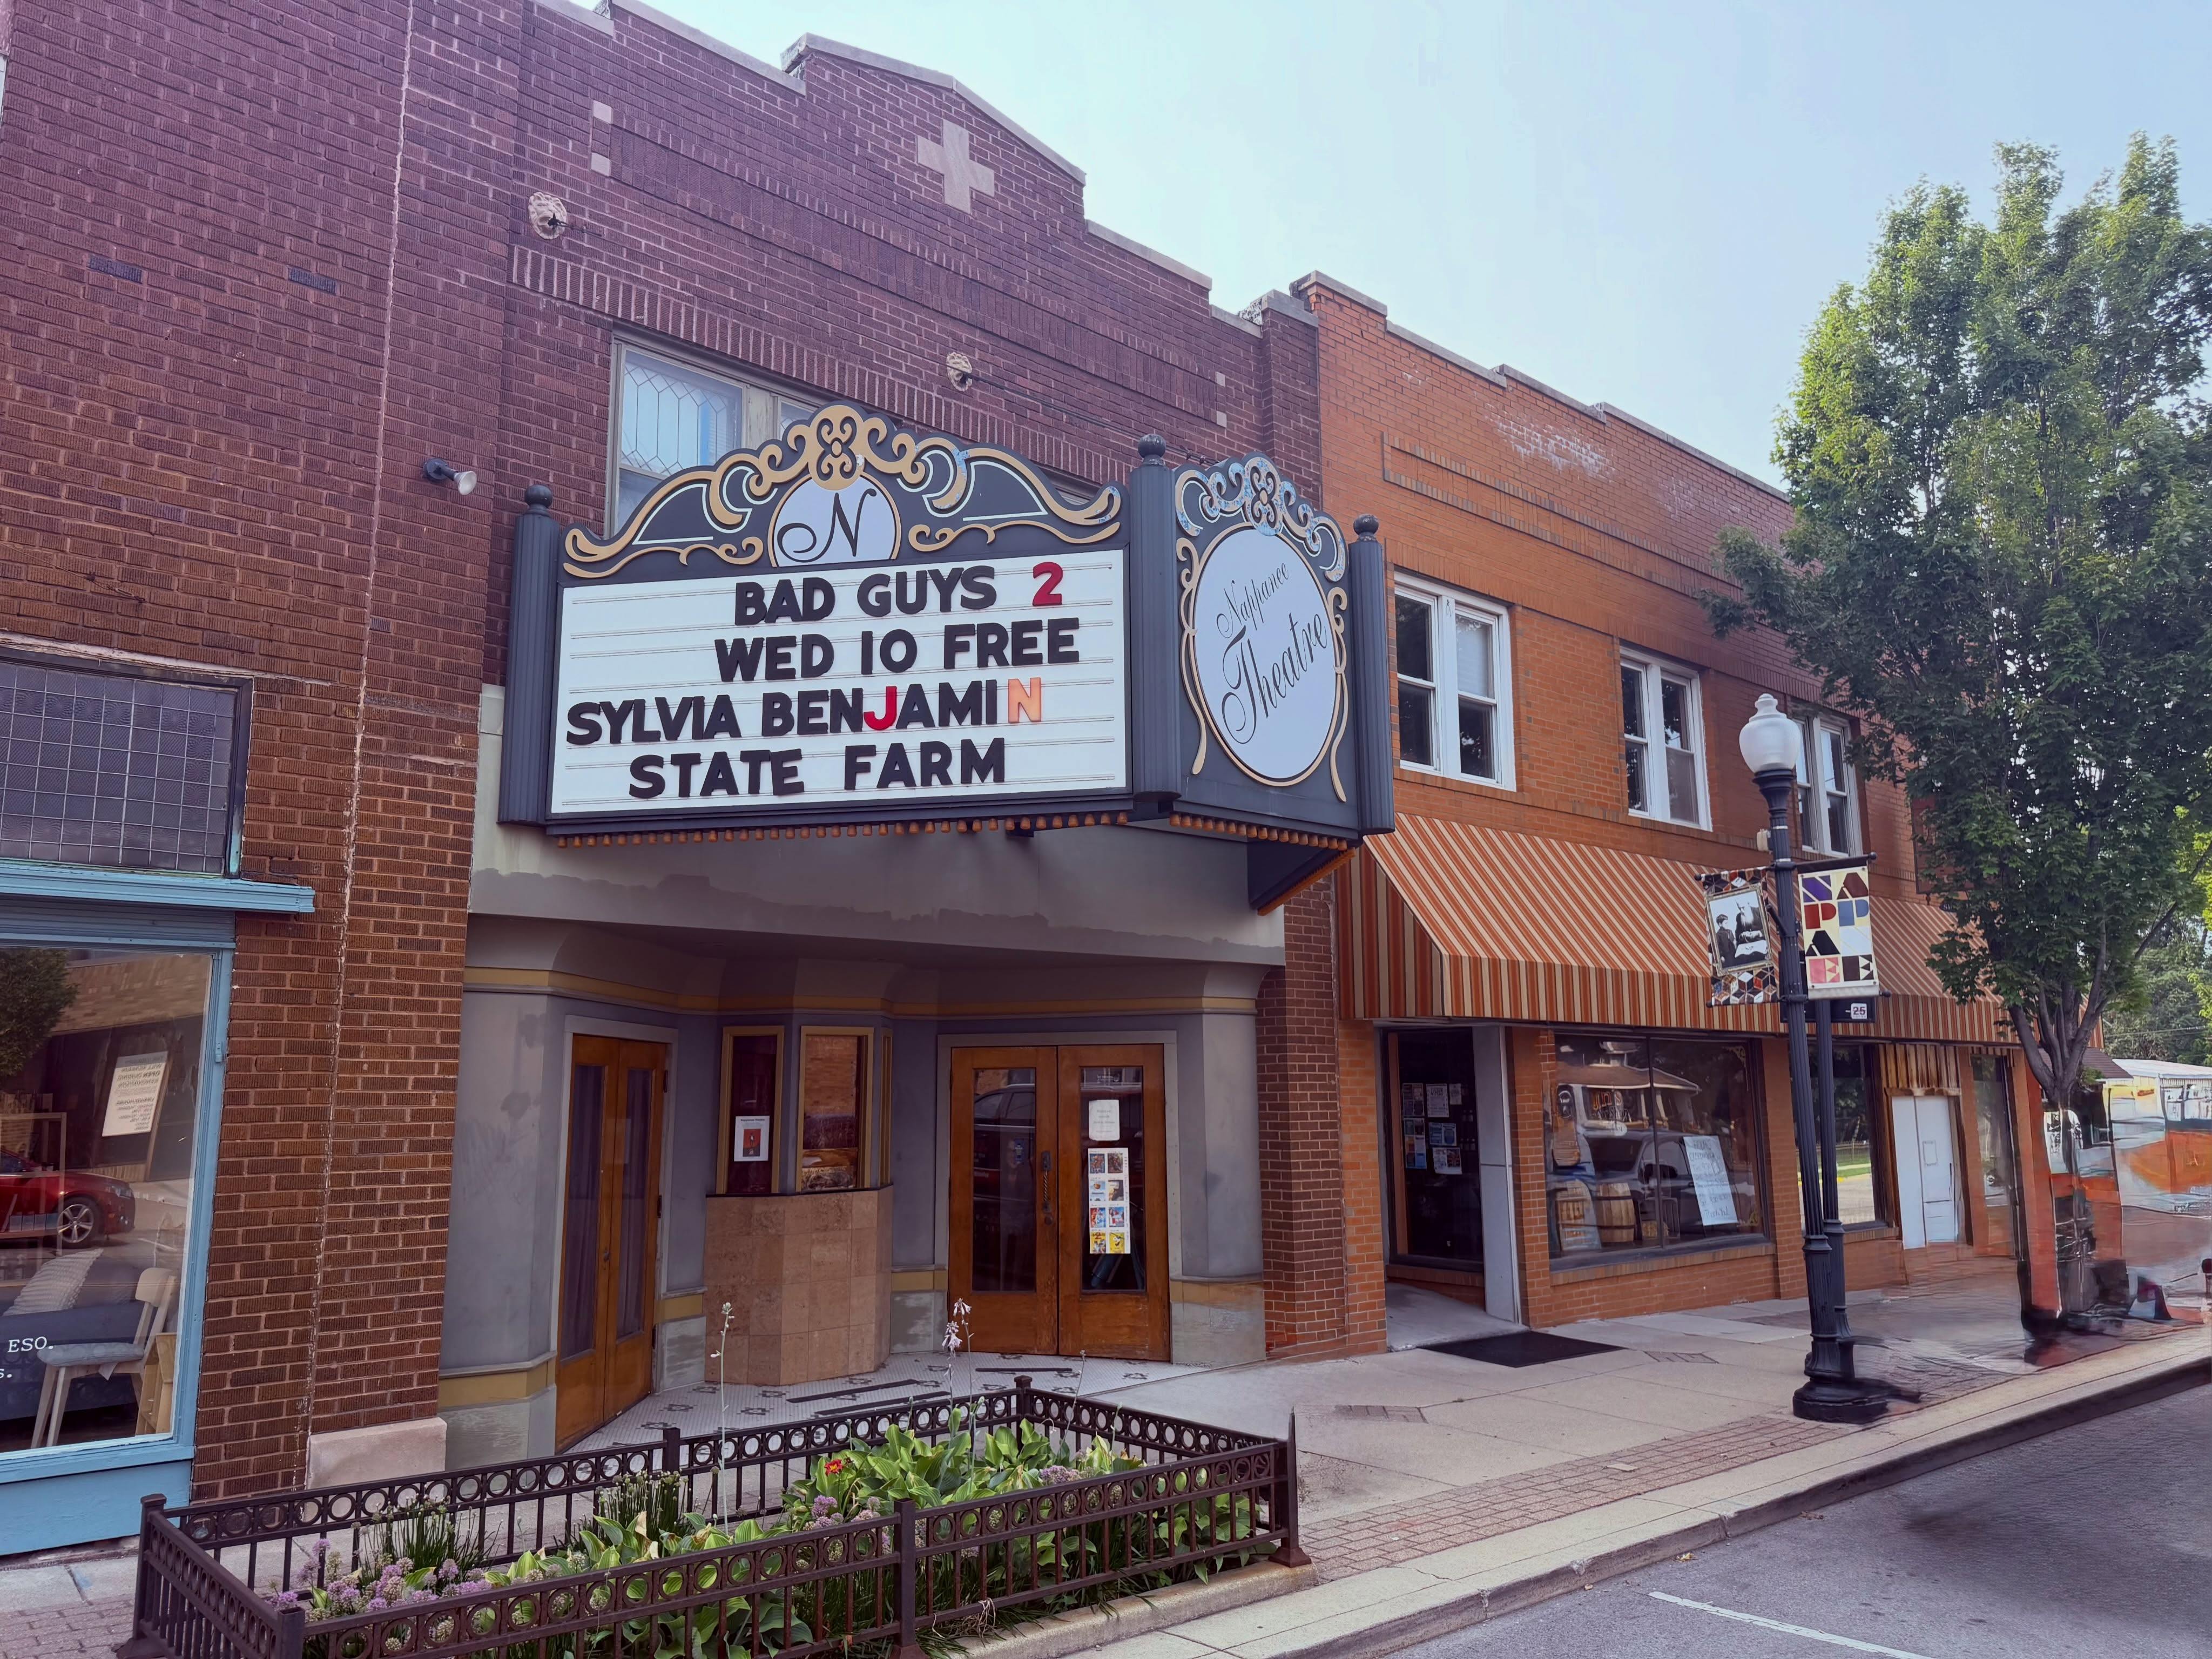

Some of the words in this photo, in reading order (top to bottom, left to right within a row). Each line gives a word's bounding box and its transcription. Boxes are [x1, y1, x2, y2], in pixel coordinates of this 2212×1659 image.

[777, 488, 876, 563] N
[734, 577, 835, 625] BAD
[857, 566, 997, 615] GUYS
[1032, 562, 1063, 606] 2
[1216, 562, 1289, 638] Nappanee
[715, 634, 834, 682] WED
[944, 617, 1080, 669] FREE
[1221, 613, 1327, 744] Theatre
[567, 694, 740, 745] SYLVIA
[761, 677, 1042, 737] BENJAMIN
[629, 748, 805, 798] STATE
[844, 738, 1005, 790] FARM
[1853, 1007, 1865, 1015] 25
[7, 1336, 53, 1353] ESO.
